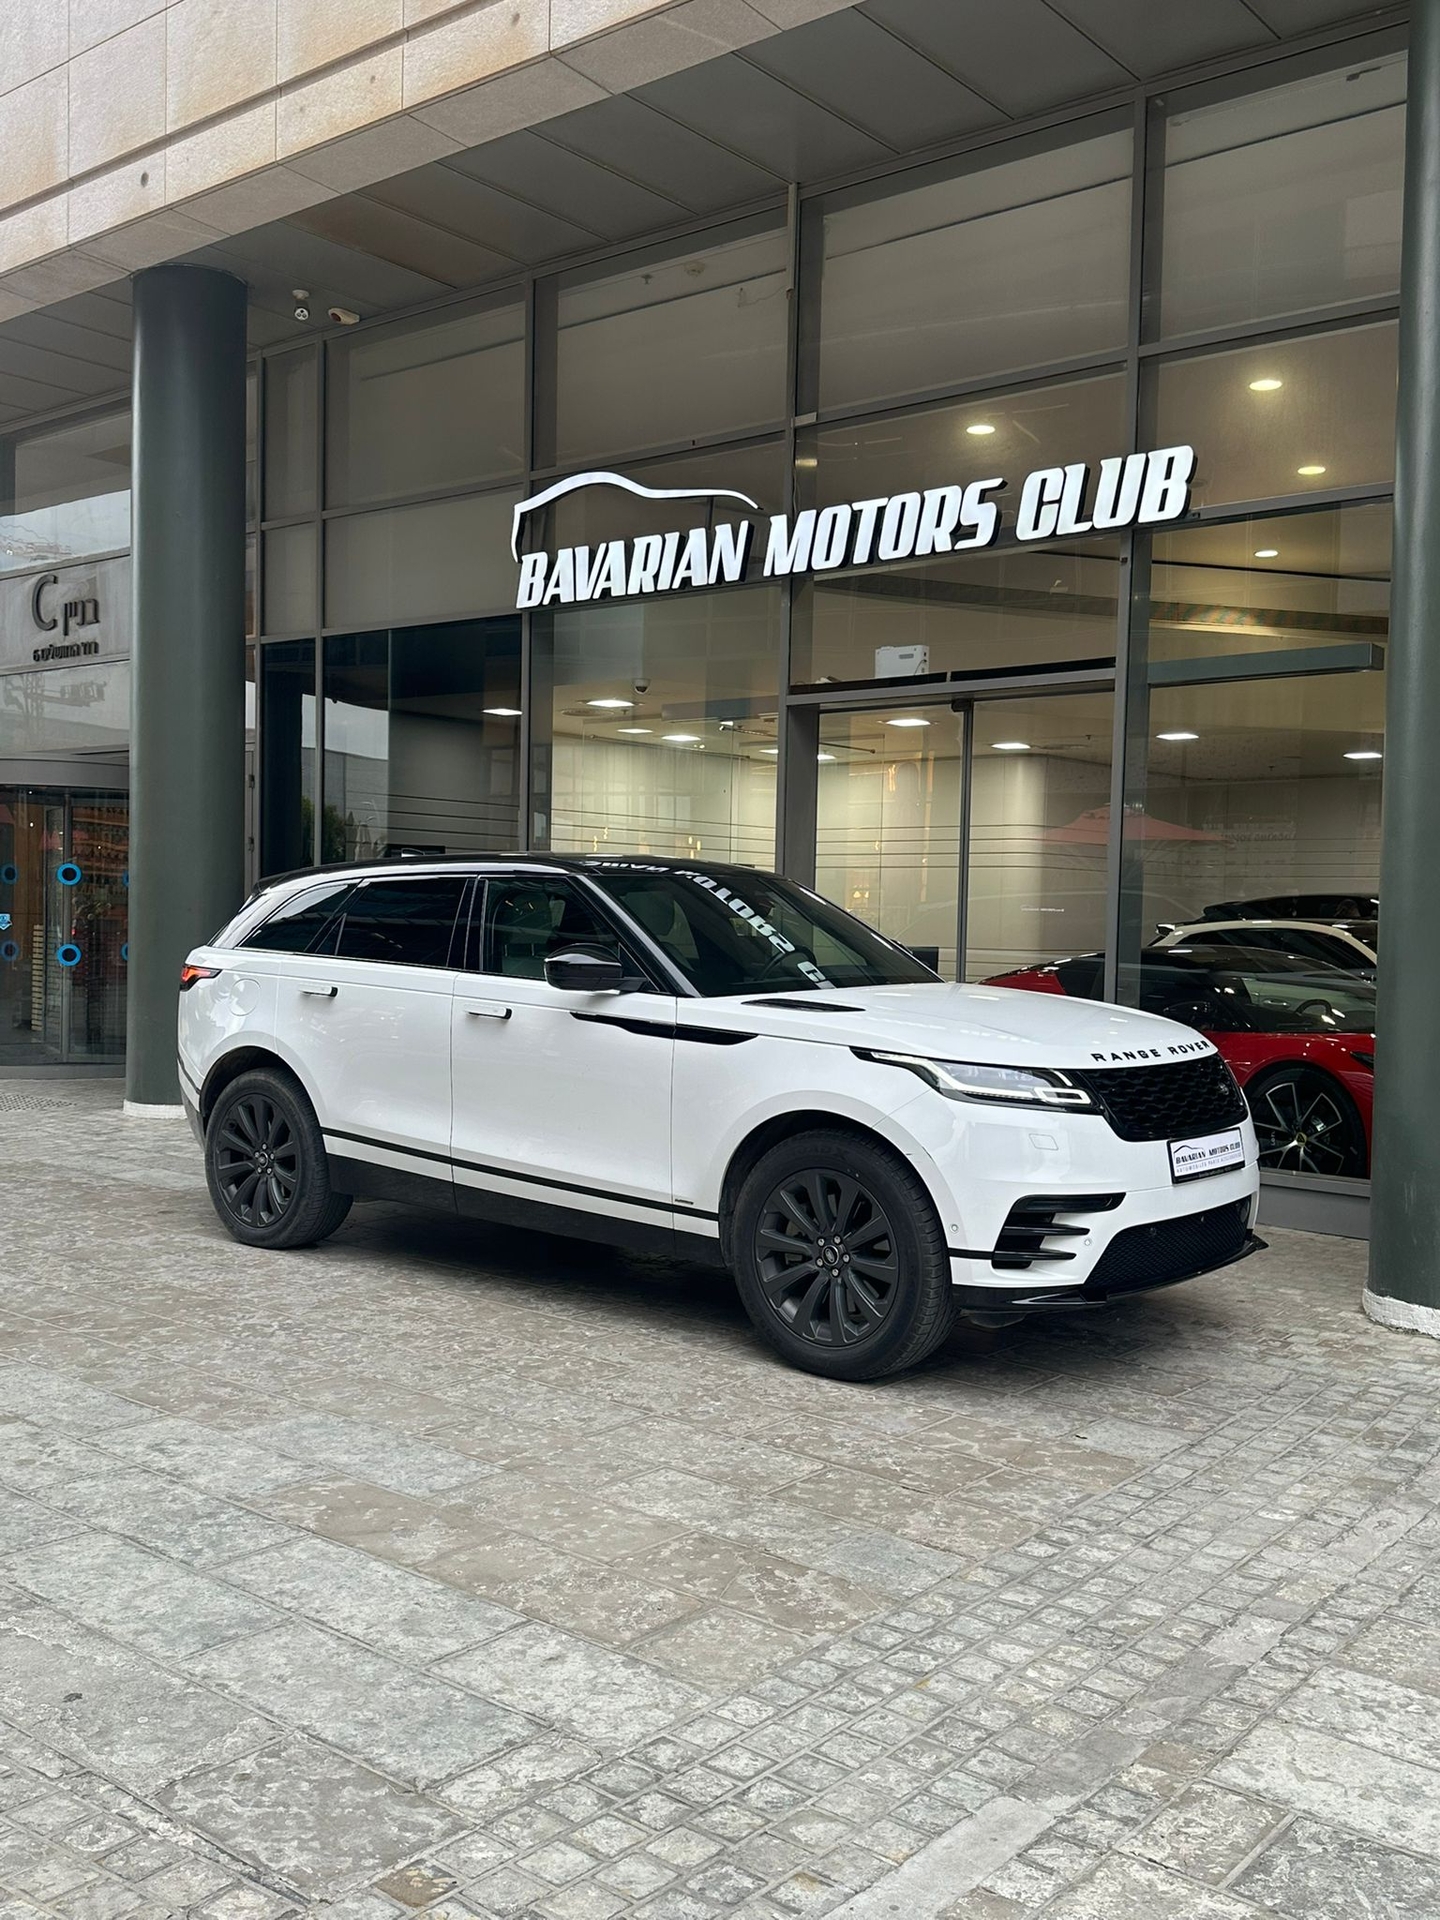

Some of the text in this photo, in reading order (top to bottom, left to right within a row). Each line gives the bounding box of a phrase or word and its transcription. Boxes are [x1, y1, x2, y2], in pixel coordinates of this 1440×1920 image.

[515, 445, 1196, 610] BAVARIAN MOTORS CLUB
[32, 573, 101, 636] בניין C
[1090, 1040, 1211, 1062] RANGE ROVER
[1176, 1151, 1206, 1165] BAVARIAN
